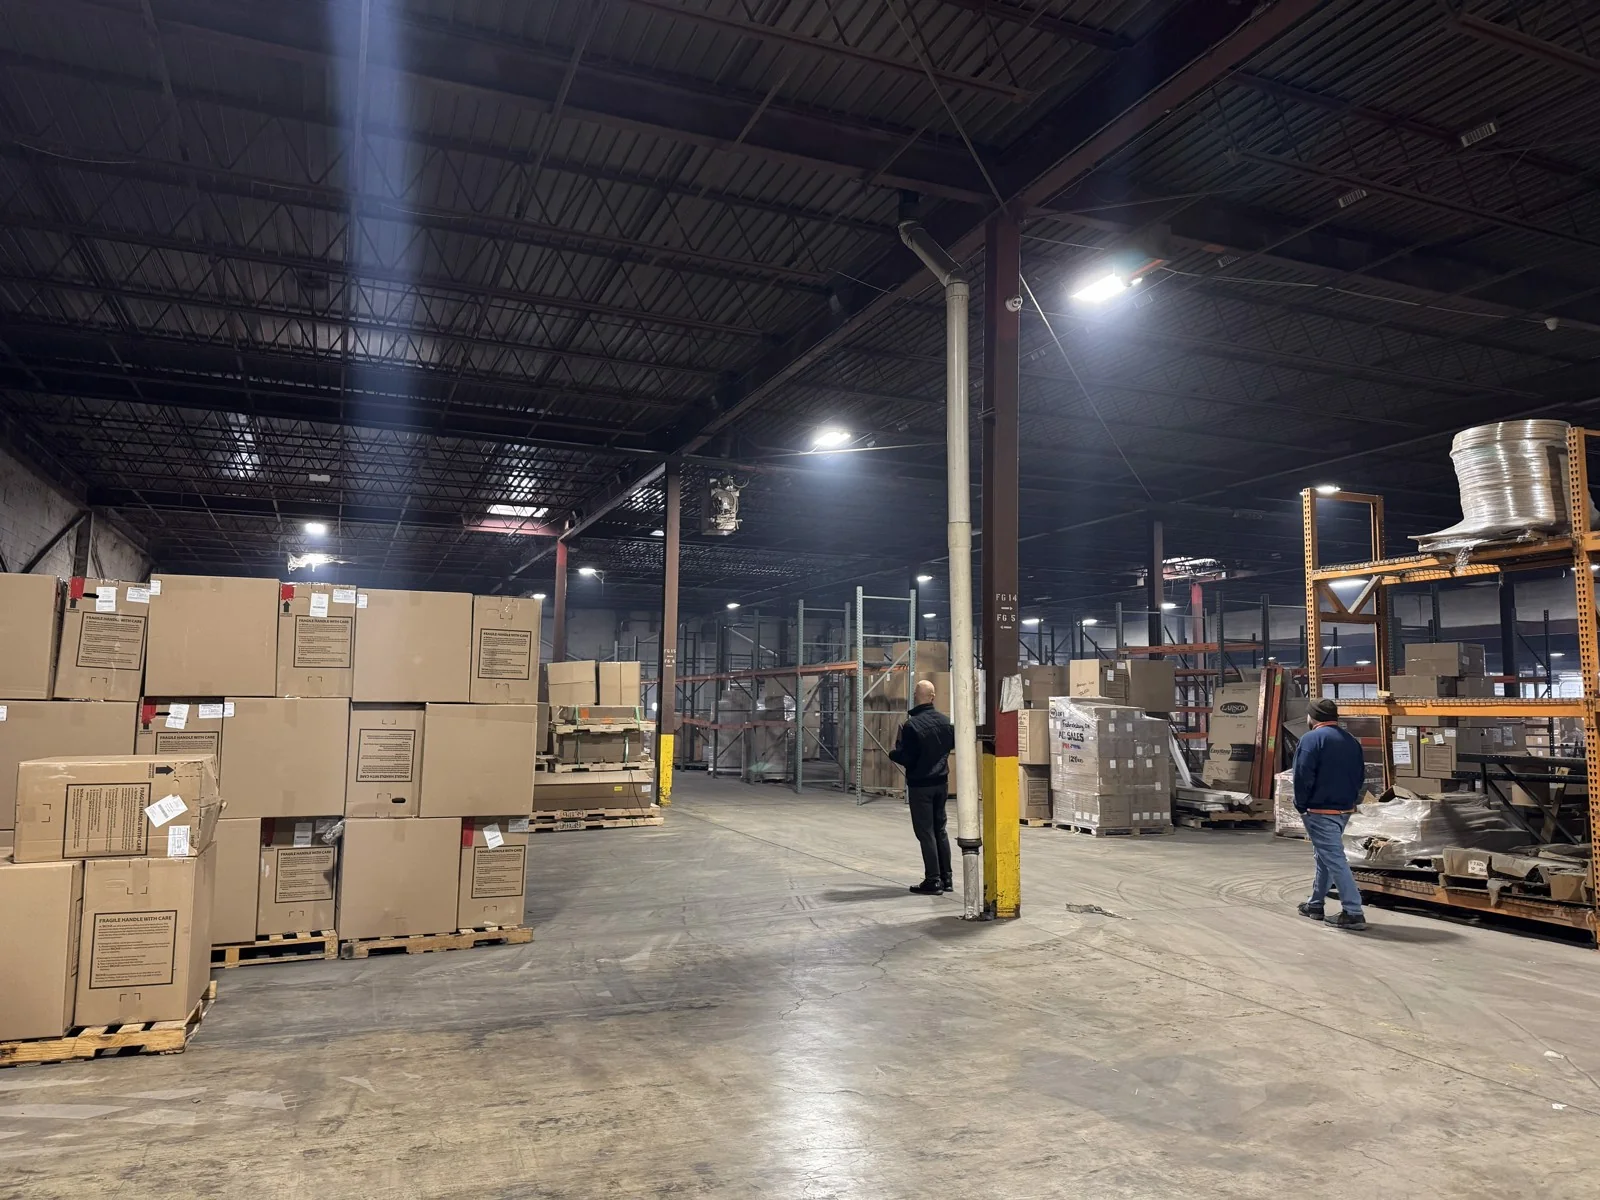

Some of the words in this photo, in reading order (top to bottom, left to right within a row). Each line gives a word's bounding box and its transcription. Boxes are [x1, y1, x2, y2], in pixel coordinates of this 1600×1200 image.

[995, 593, 1006, 602] FG
[1008, 594, 1017, 602] 14
[996, 614, 1007, 622] FG
[1221, 704, 1248, 712] LARSON
[1066, 732, 1084, 742] SALES
